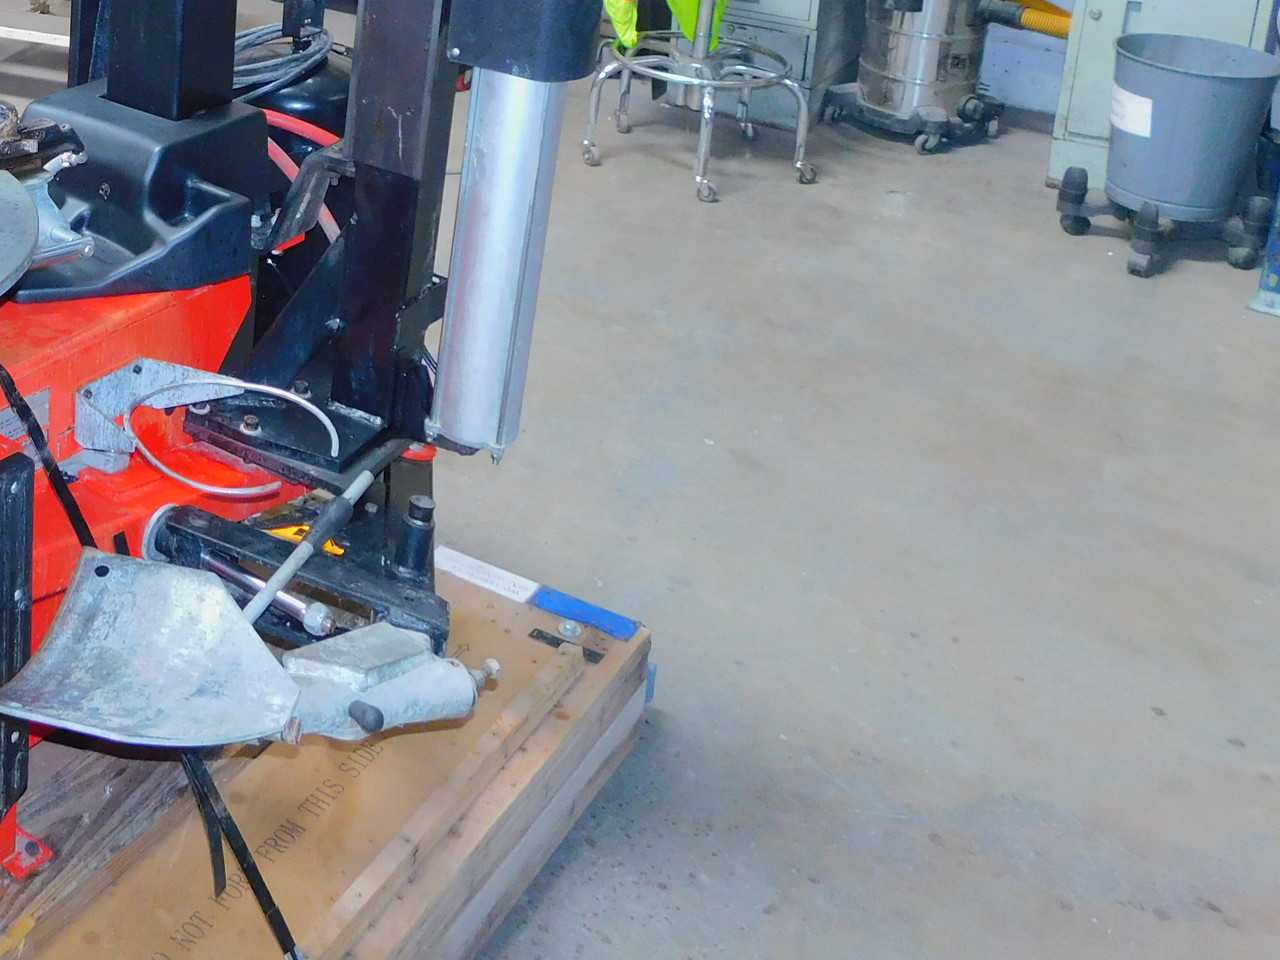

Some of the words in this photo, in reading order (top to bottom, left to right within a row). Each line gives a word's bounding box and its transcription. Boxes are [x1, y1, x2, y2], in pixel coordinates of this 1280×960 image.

[168, 909, 215, 953] NOT
[253, 816, 307, 863] FROM
[297, 778, 346, 821] THIS
[338, 742, 385, 778] SIDE
